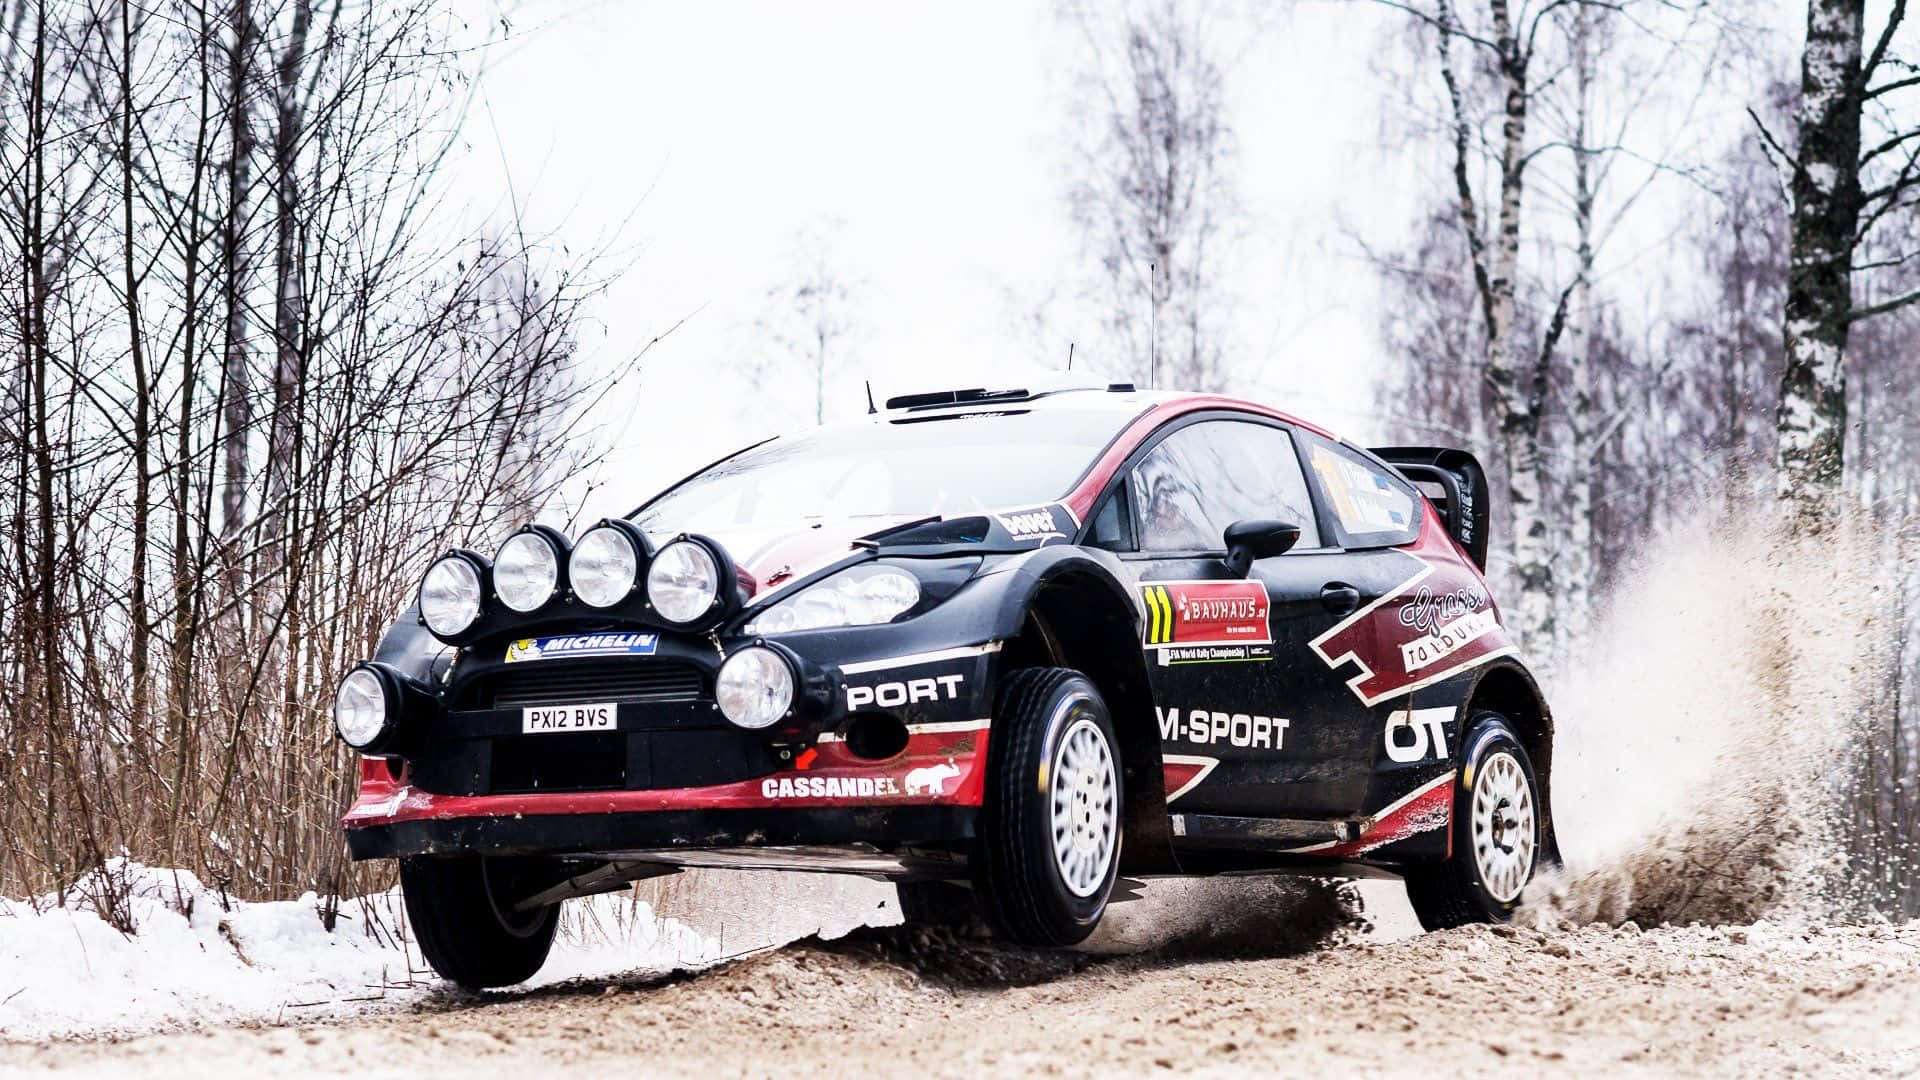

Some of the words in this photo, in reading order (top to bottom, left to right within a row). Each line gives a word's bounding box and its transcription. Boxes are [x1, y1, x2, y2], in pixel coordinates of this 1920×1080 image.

[1144, 585, 1172, 644] 11
[1191, 599, 1256, 619] BAUHAUS
[543, 634, 656, 650] MICHELIN
[1181, 649, 1196, 659] World
[1196, 648, 1210, 660] Rally
[1210, 647, 1245, 659] Championship
[846, 674, 964, 711] PORT
[575, 708, 609, 727] BVS
[1155, 706, 1290, 749] M-SPORT
[1384, 706, 1458, 763] OT
[761, 777, 900, 798] CASSANDEL
